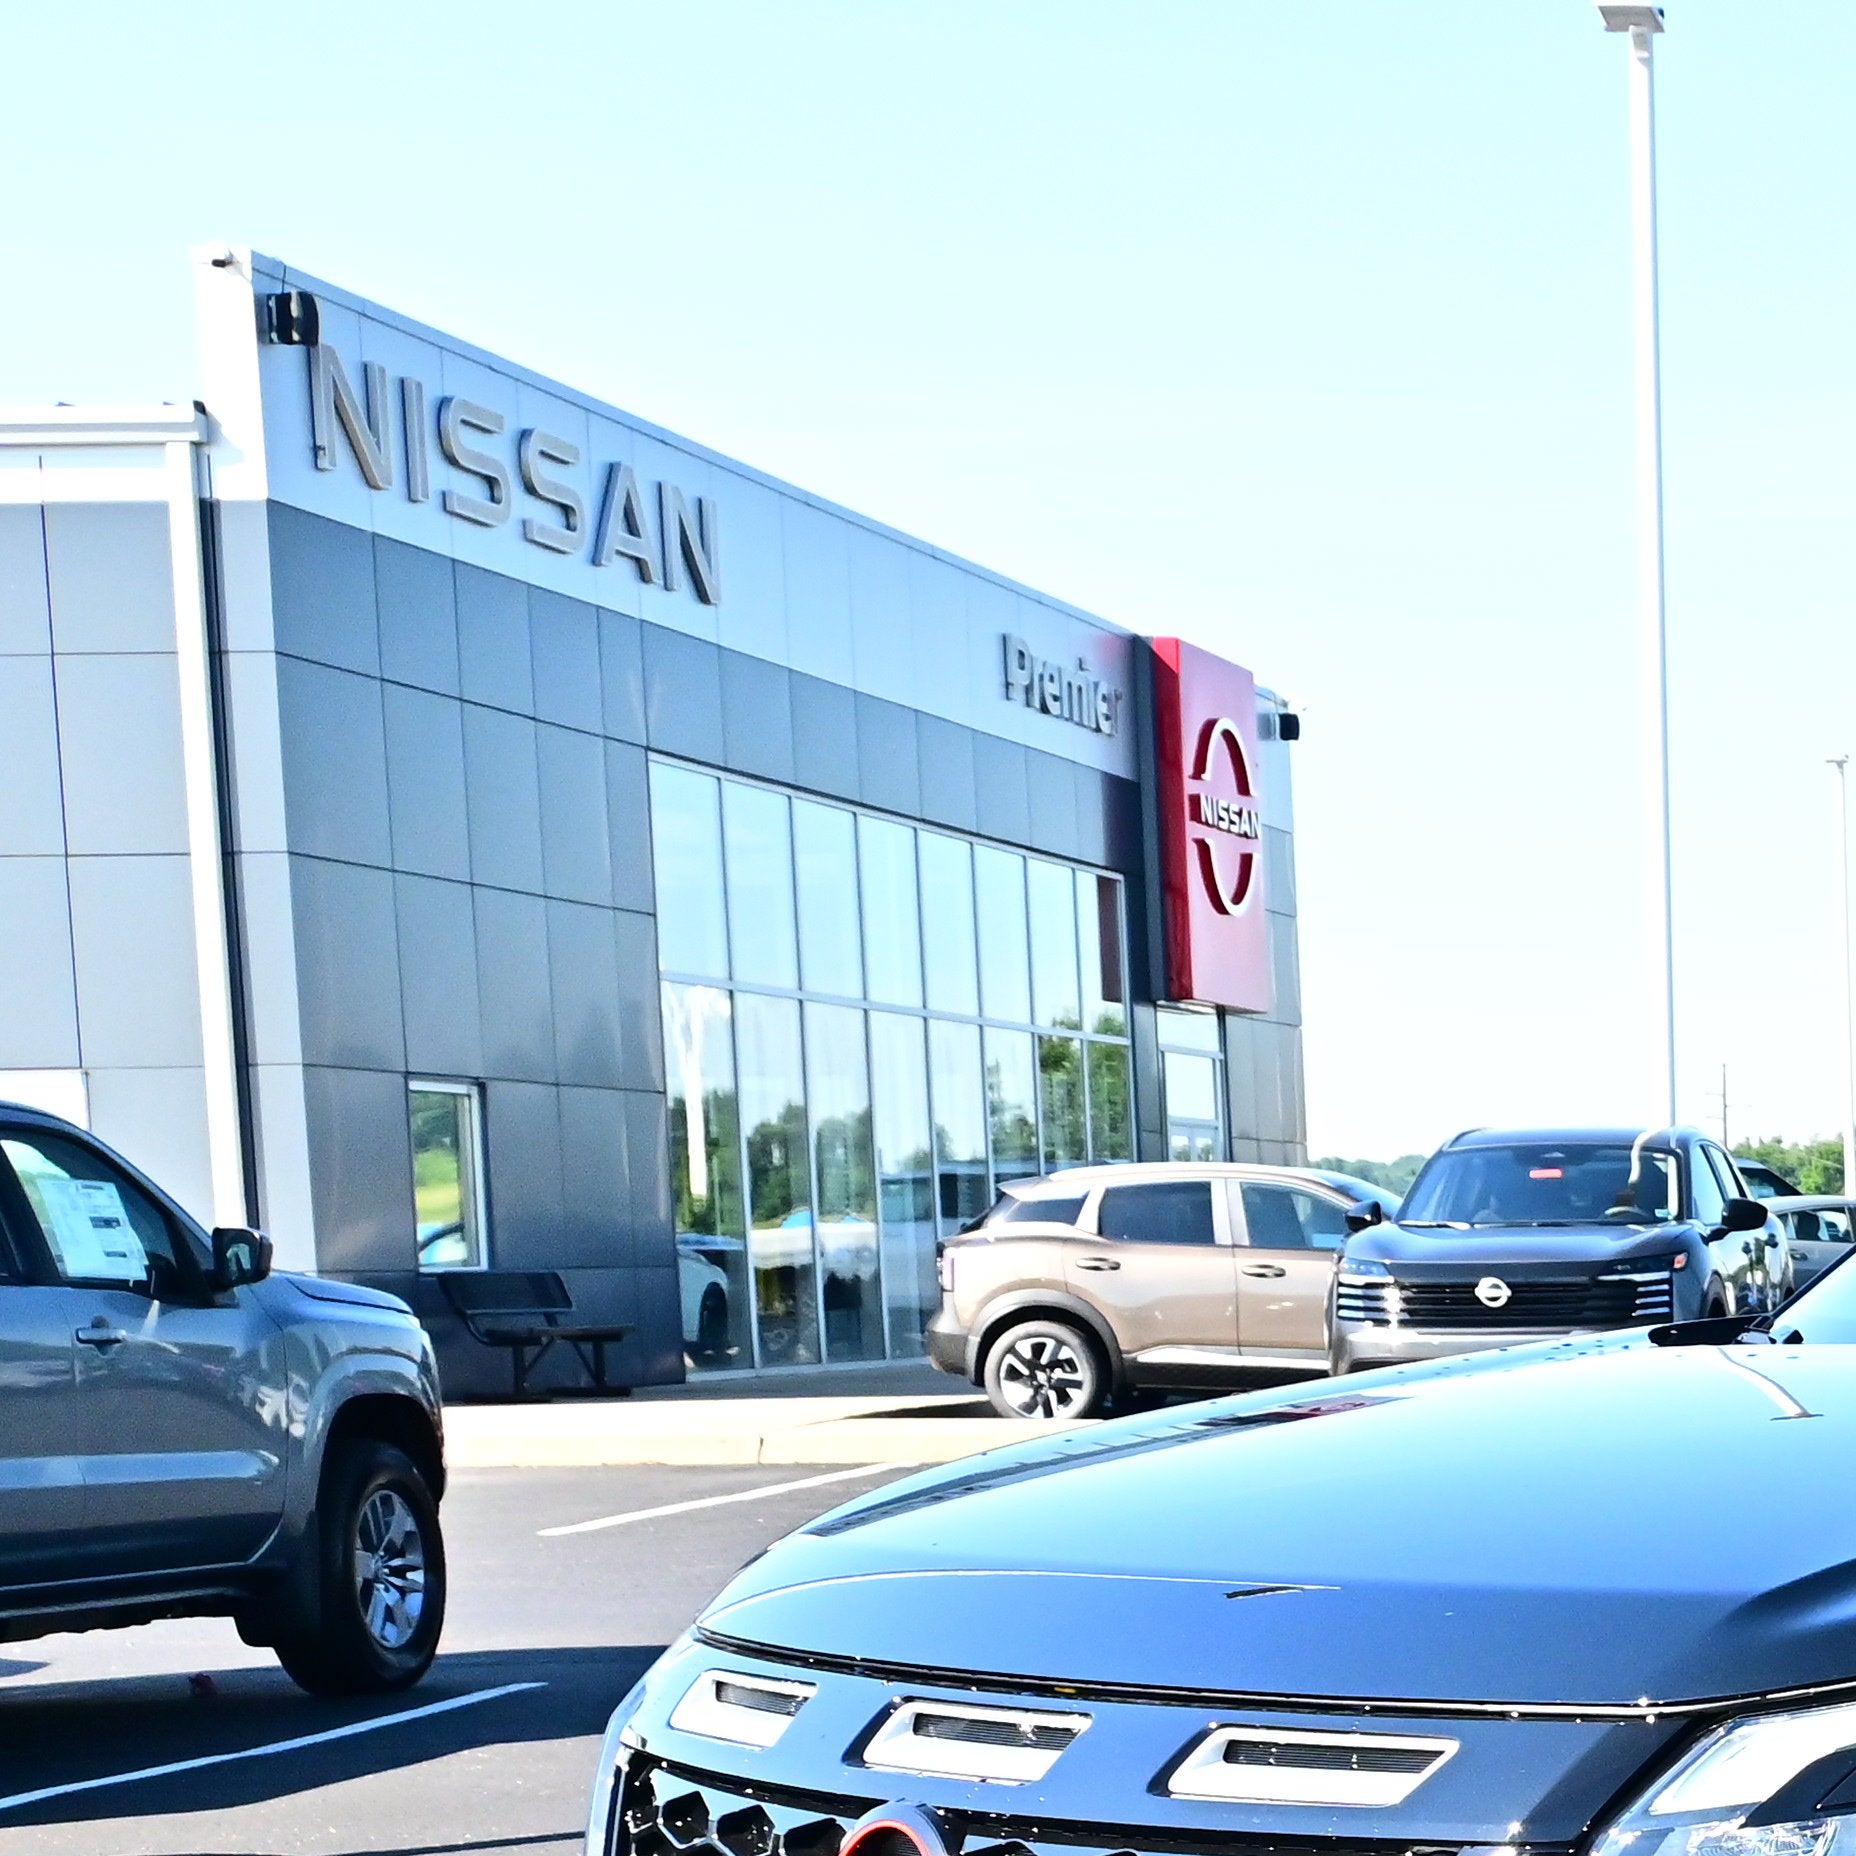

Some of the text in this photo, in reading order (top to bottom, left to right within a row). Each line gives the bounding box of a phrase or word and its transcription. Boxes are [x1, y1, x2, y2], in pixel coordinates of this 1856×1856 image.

[307, 342, 721, 605] NISSAN
[1001, 631, 1124, 738] Premier
[1200, 794, 1261, 840] NISSAN
